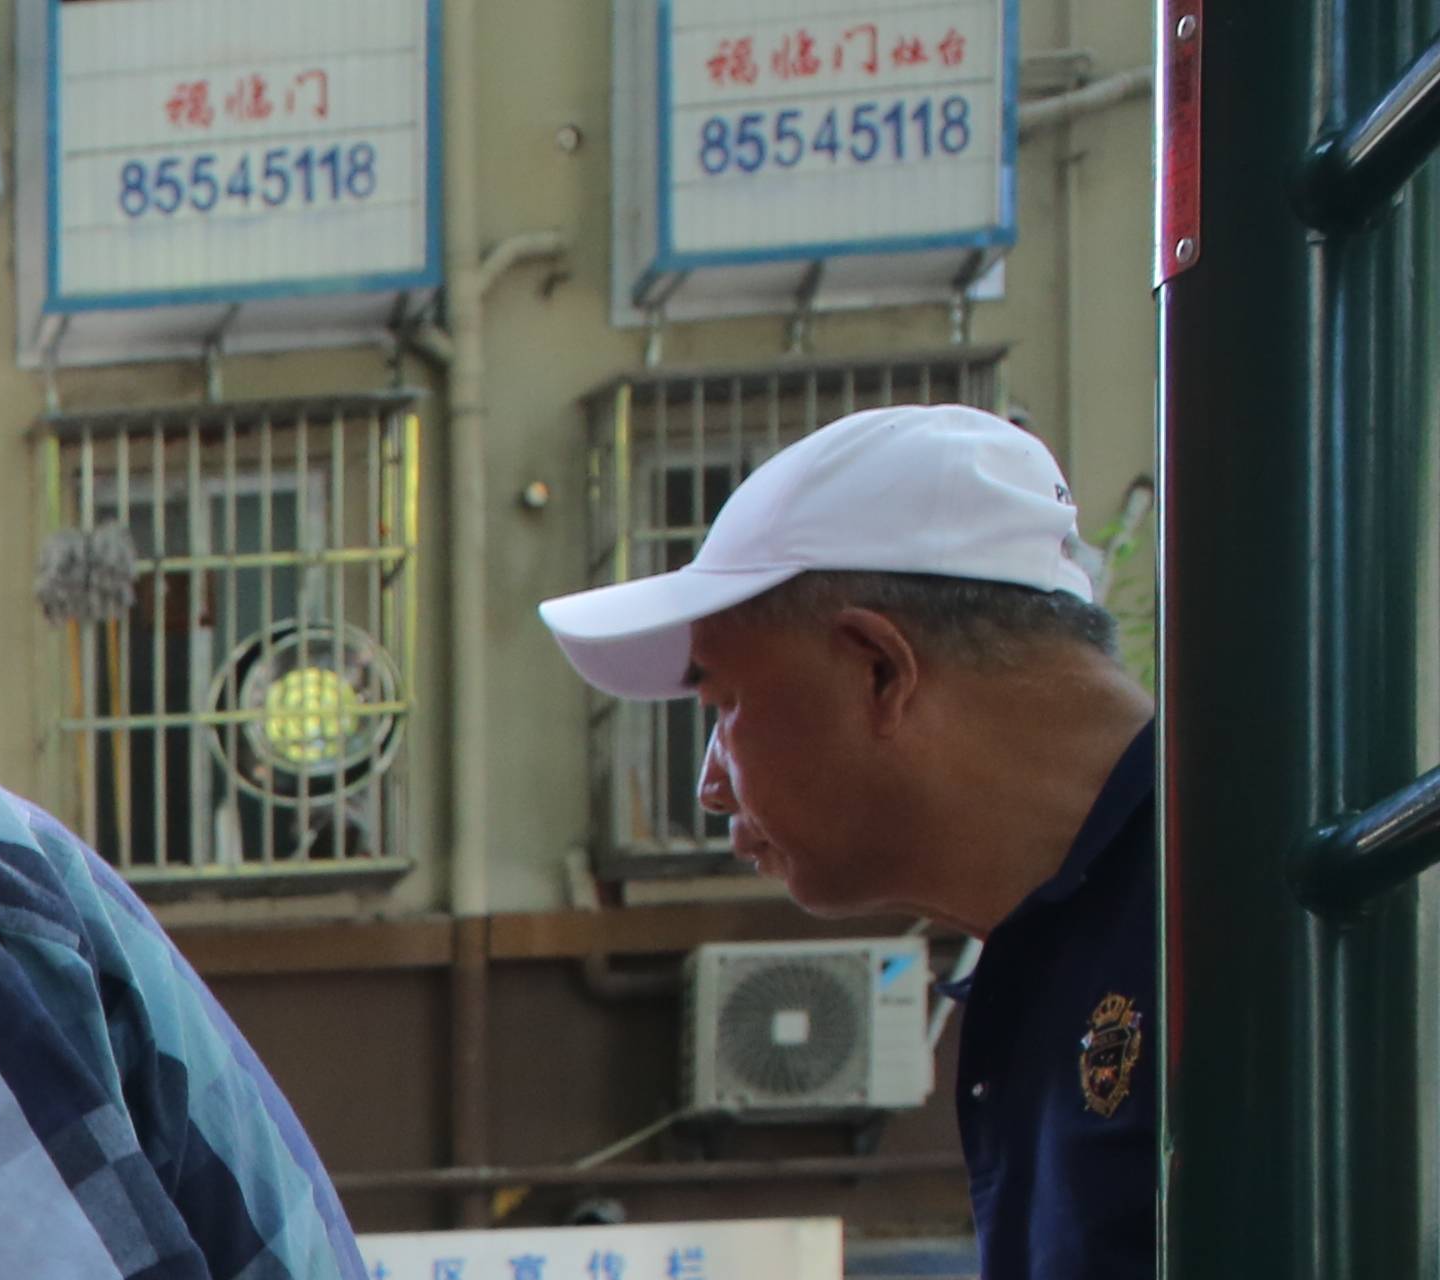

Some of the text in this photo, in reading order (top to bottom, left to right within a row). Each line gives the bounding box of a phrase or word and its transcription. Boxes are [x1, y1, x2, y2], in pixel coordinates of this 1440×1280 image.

[164, 67, 328, 128] 福临门
[699, 95, 970, 176] 85545118
[118, 141, 377, 218] 85545118
